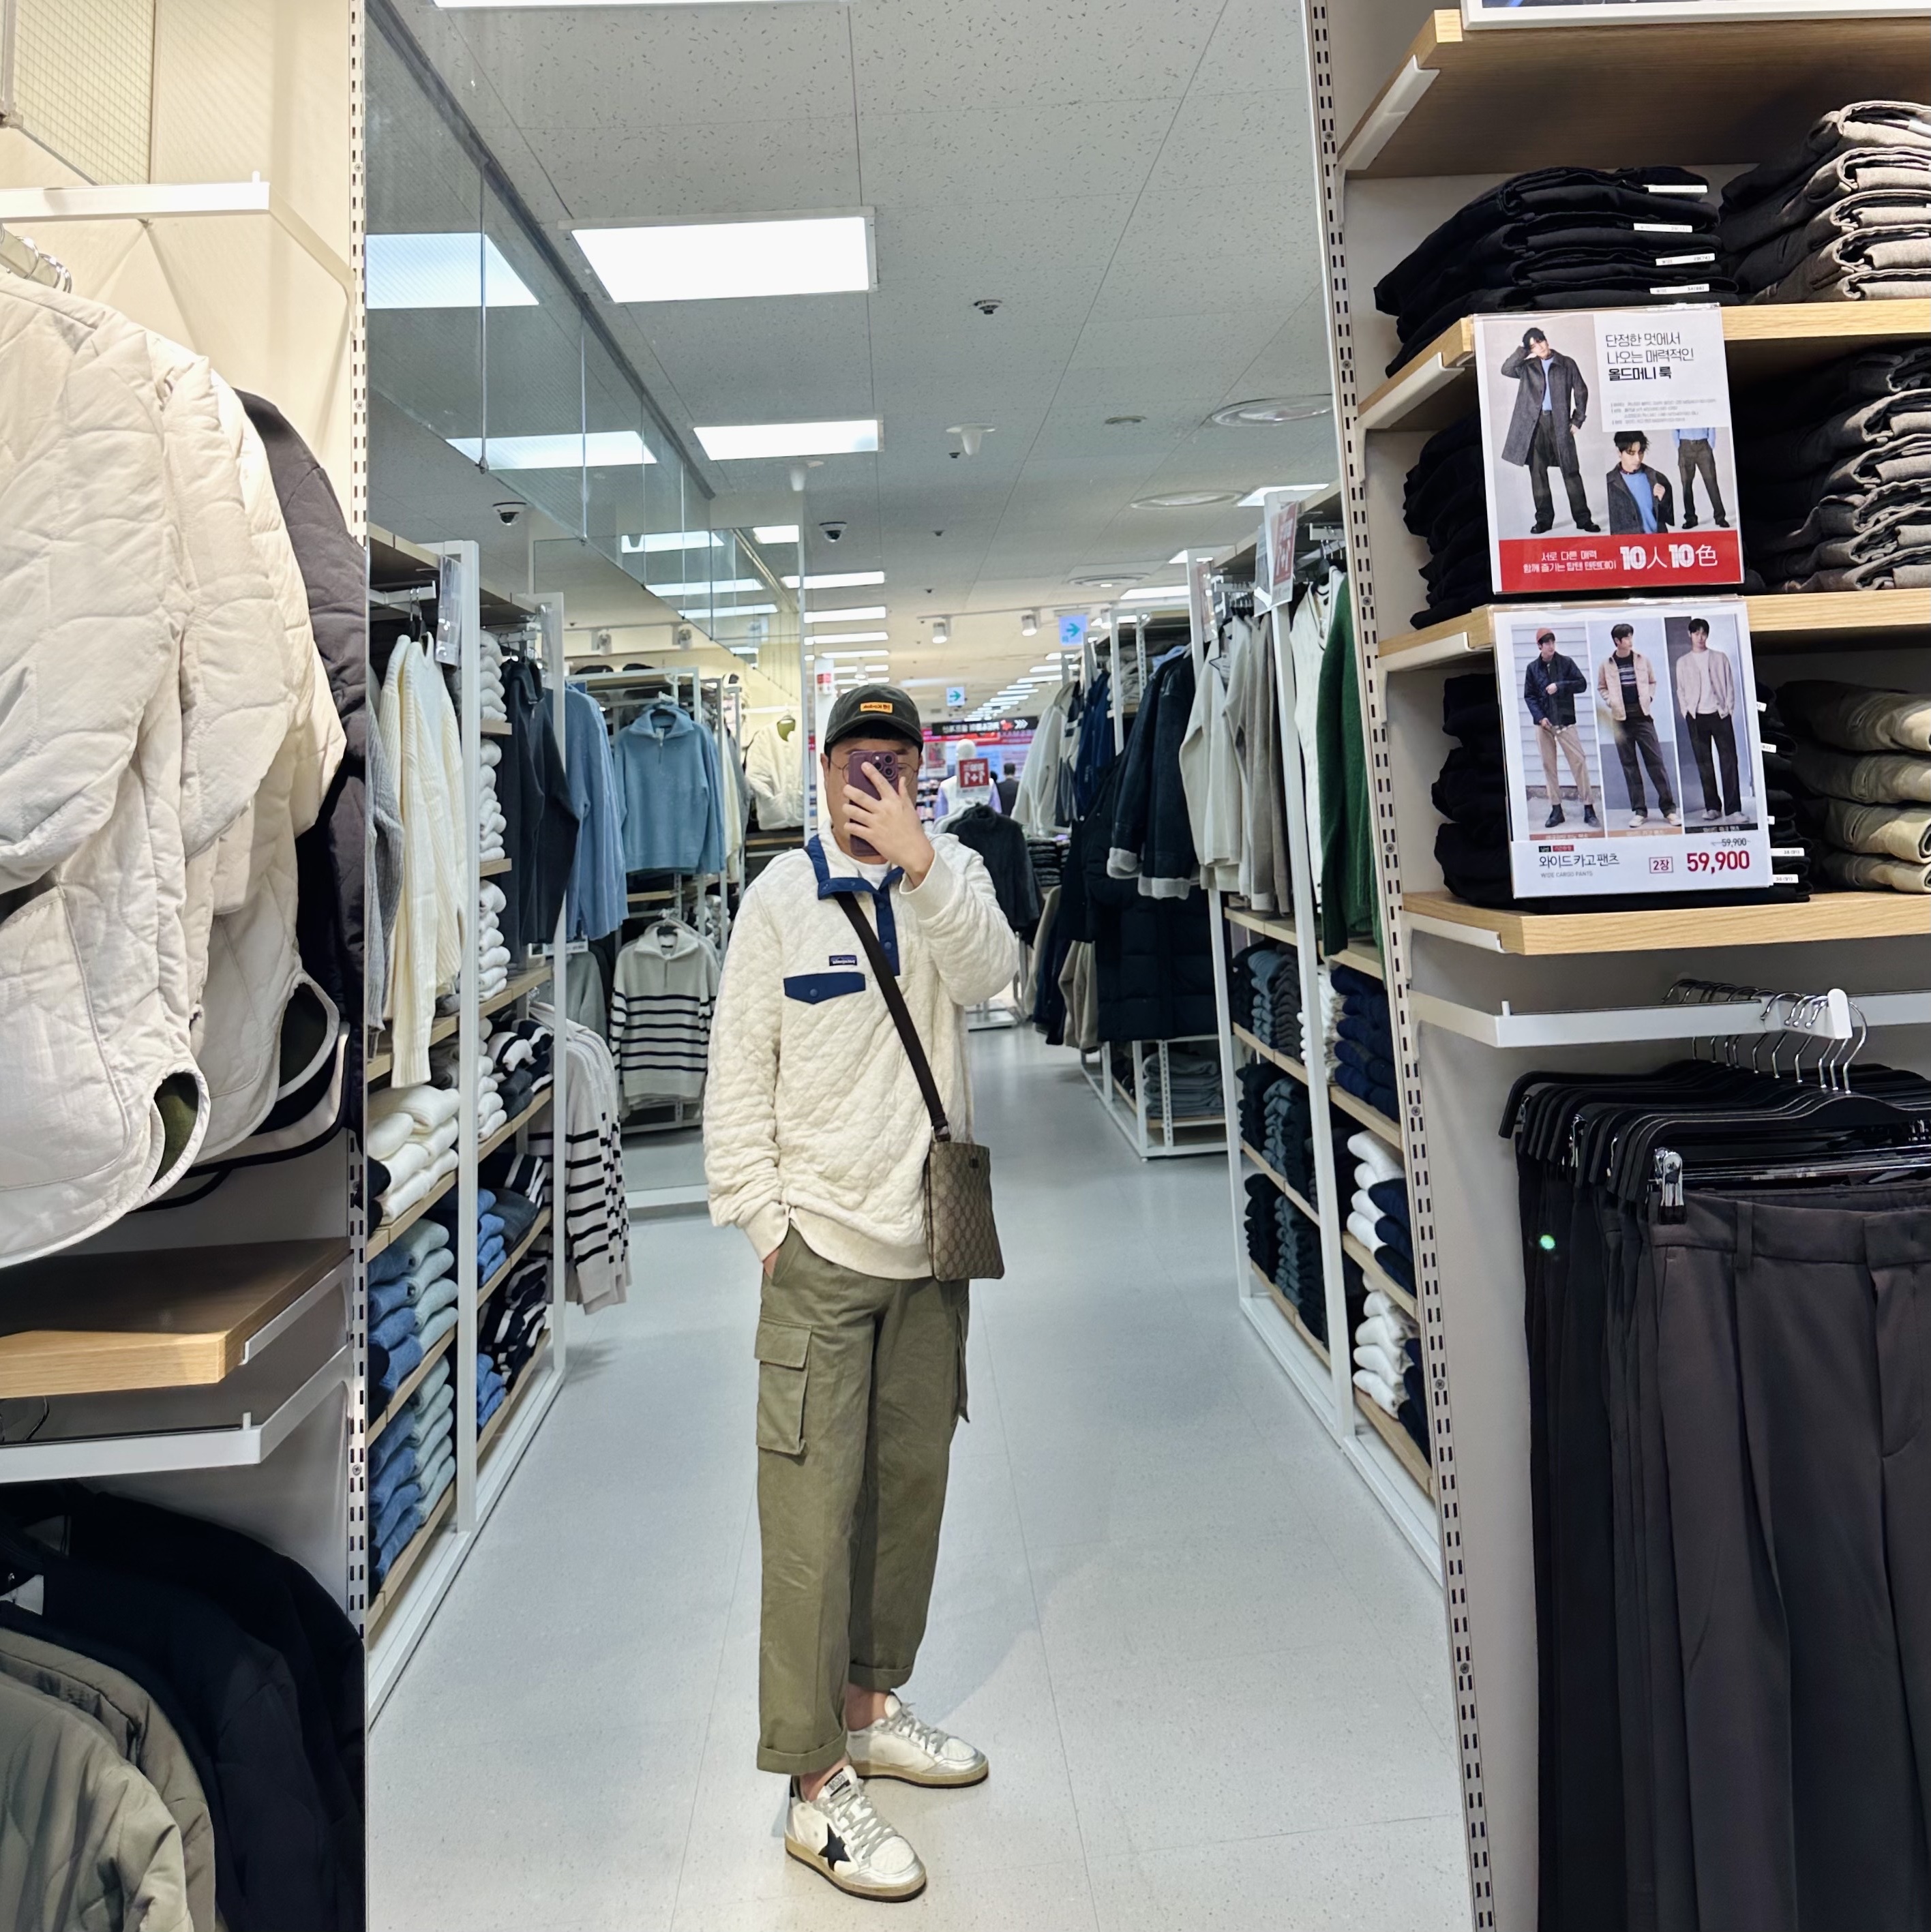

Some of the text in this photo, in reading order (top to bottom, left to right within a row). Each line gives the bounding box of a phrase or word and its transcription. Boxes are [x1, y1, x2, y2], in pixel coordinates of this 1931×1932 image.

[1605, 331, 1681, 348] 단정한 멋에서
[1606, 348, 1694, 364] 나오는 매력적인
[1608, 366, 1672, 381] 올드머니 룩
[1541, 550, 1597, 561] 서로 다른 매력
[1523, 563, 1540, 573] 함께
[1541, 562, 1566, 573] 즐기는
[1721, 838, 1747, 848] 59,900
[1652, 859, 1670, 871] 2장
[1686, 849, 1750, 874] 59,900
